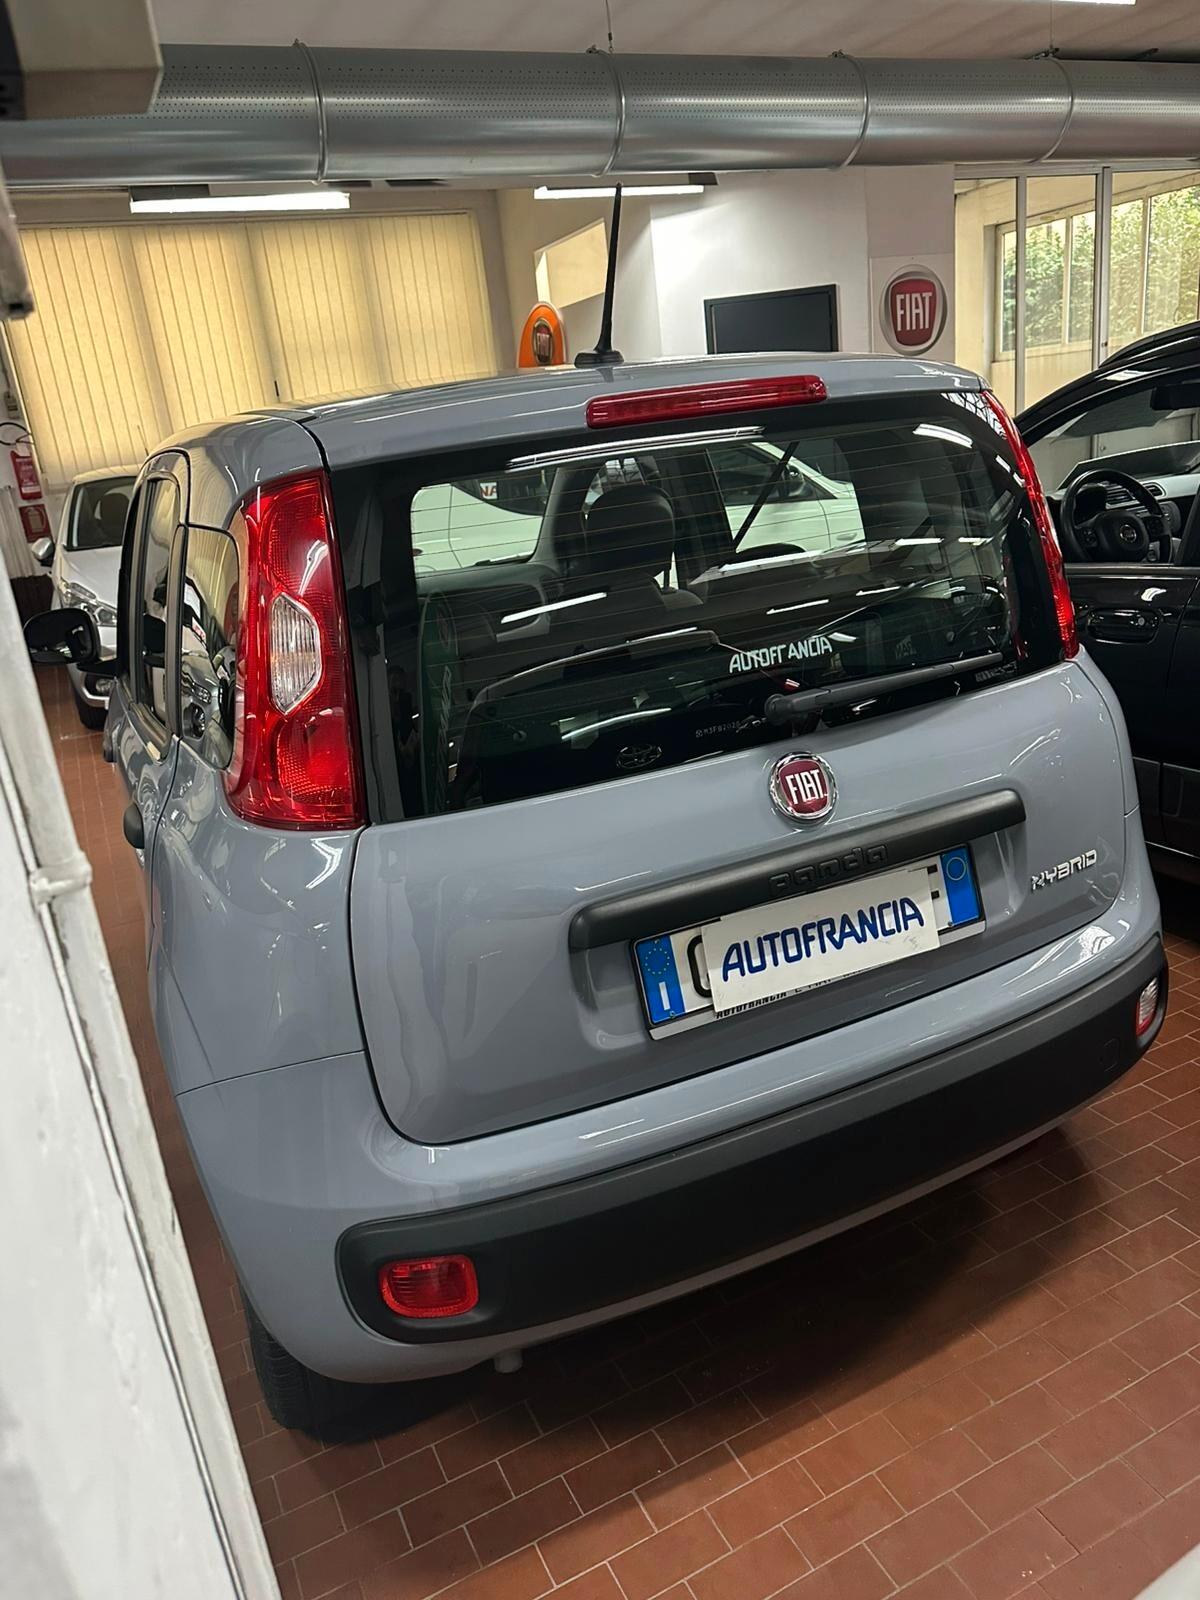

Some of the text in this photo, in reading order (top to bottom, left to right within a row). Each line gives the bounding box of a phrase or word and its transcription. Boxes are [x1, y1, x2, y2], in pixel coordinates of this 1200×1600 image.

[896, 292, 932, 331] FIAT
[785, 769, 824, 804] FIAT
[1031, 849, 1097, 891] HYBRID
[722, 897, 925, 982] AUTOFRANCIA
